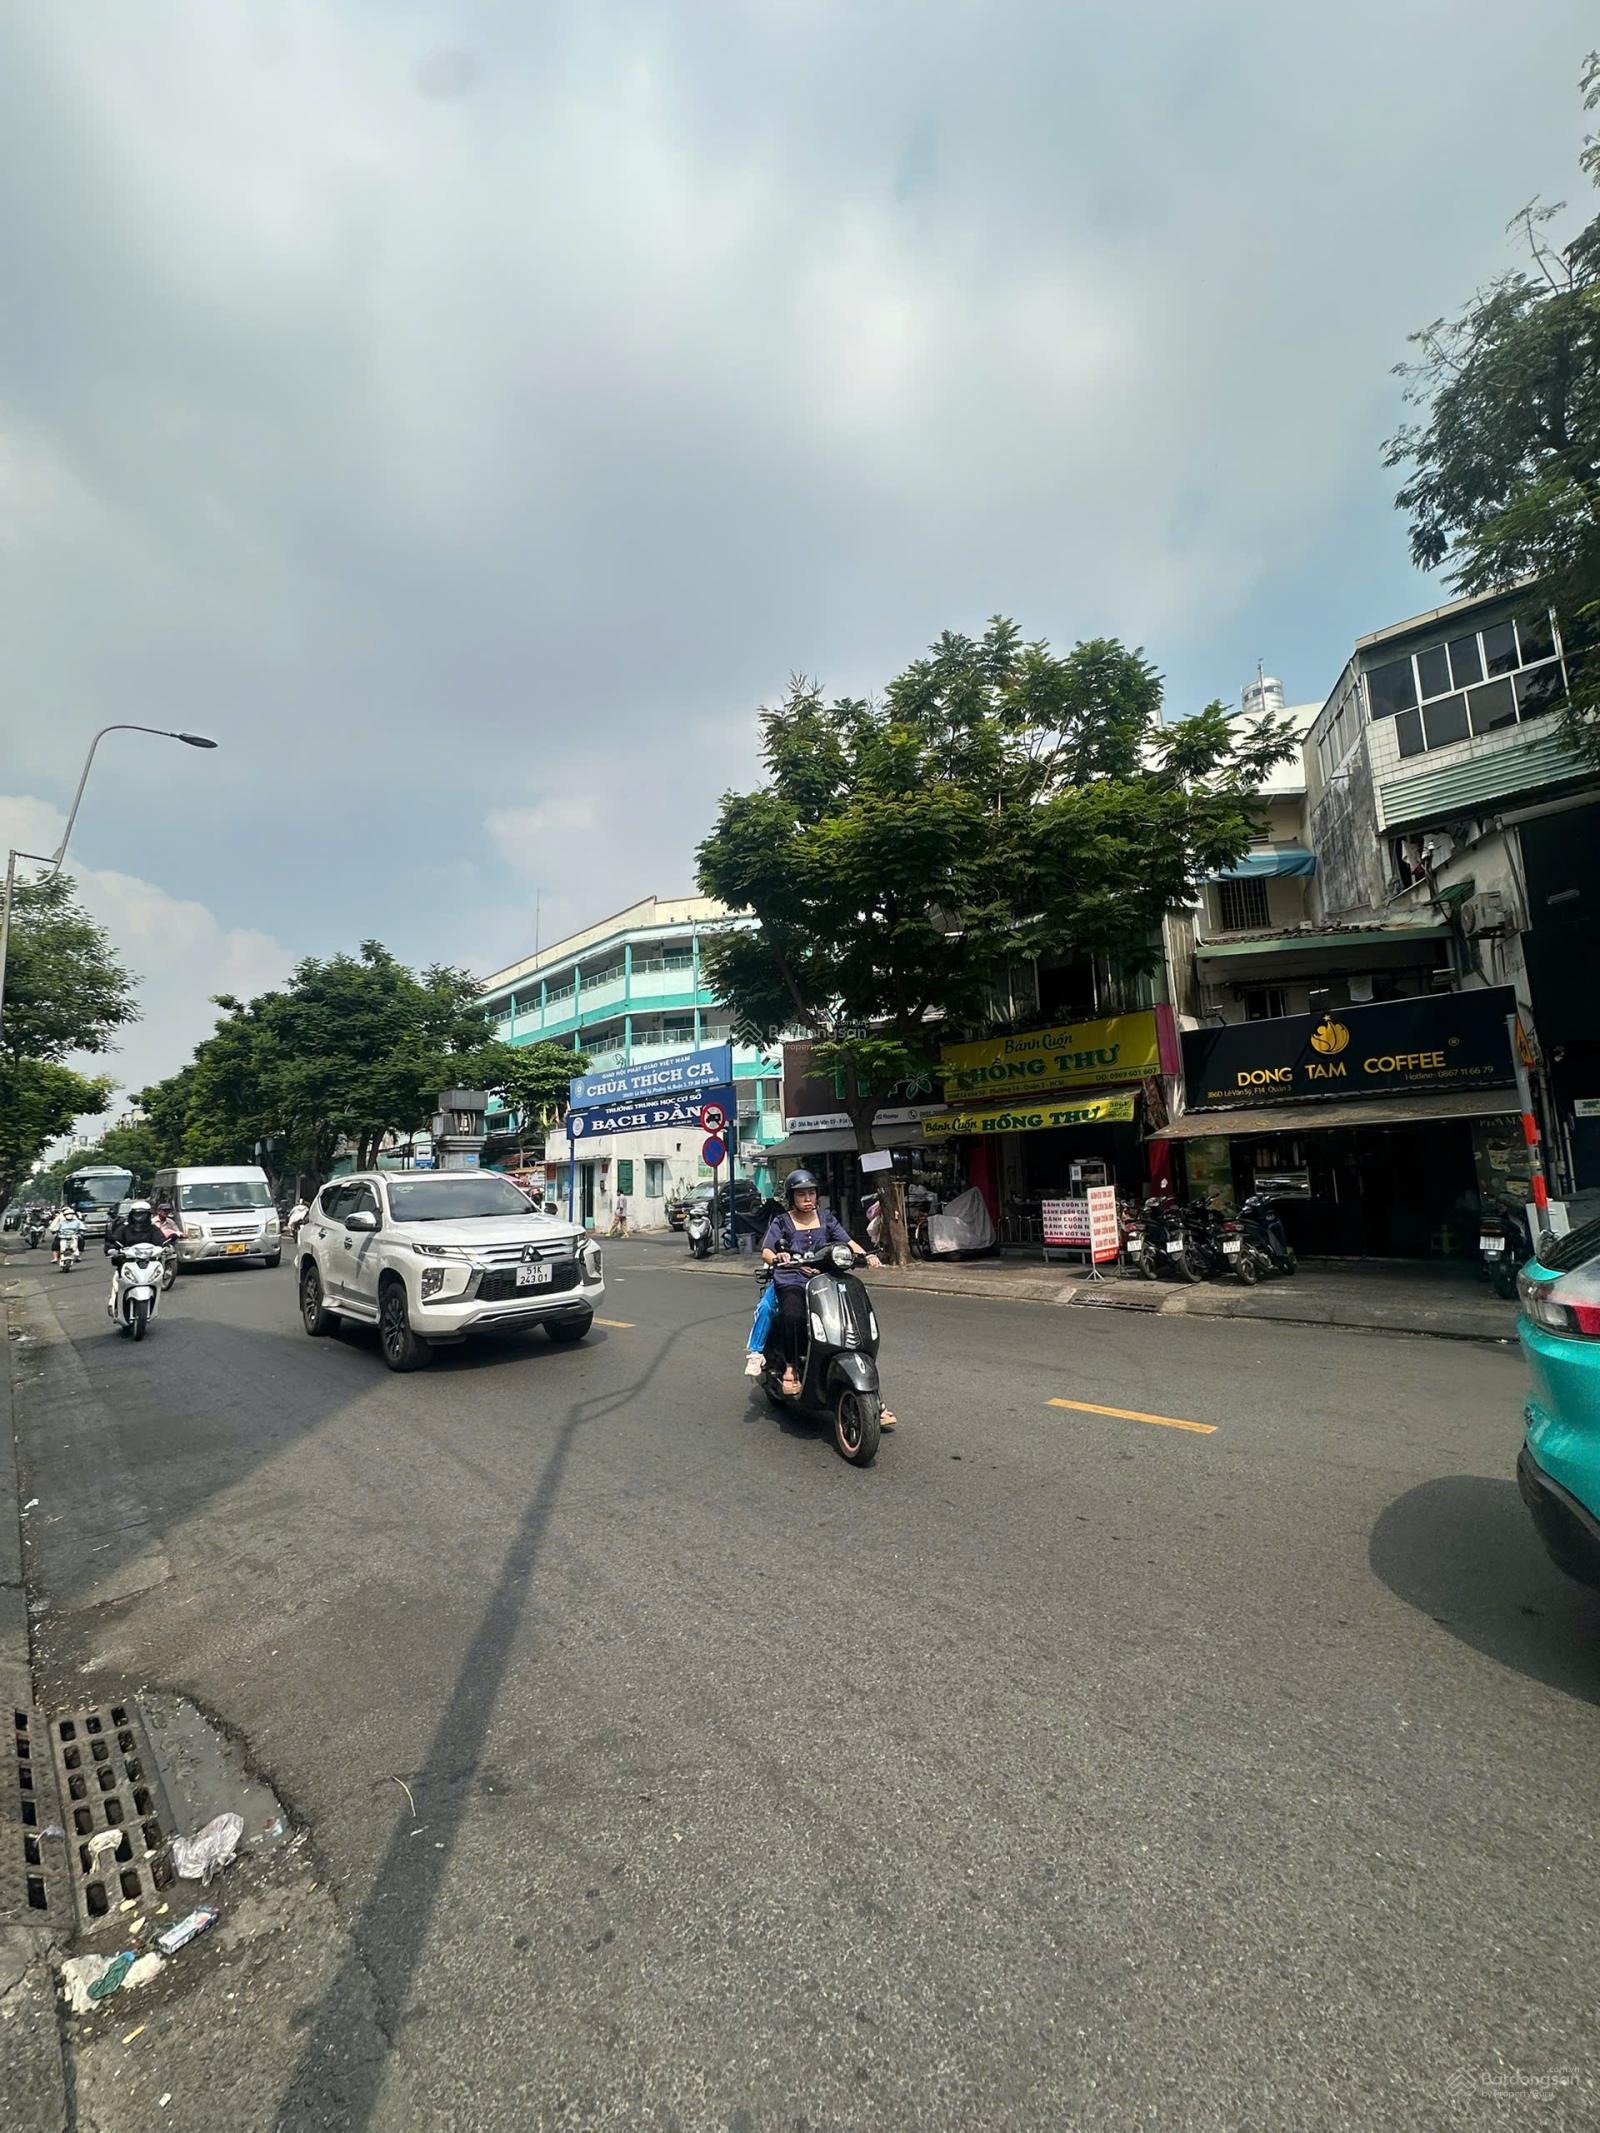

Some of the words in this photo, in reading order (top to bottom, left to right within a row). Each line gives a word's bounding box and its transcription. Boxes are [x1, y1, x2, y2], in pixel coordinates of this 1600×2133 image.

[1004, 1038, 1040, 1054] Bánh
[1042, 1031, 1073, 1050] Cuốn
[675, 1055, 691, 1064] NAM
[1054, 1043, 1120, 1073] THƯ
[1236, 1066, 1294, 1087] DONG
[1304, 1060, 1348, 1081] TAM
[1363, 1050, 1447, 1074] COFFEE
[586, 1079, 627, 1098] CHÙA
[631, 1068, 683, 1089] THÍCH
[687, 1062, 714, 1078] CA
[605, 1104, 633, 1114] TRƯỜNG
[634, 1100, 659, 1110] TRUNG
[660, 1098, 676, 1106] HỌC
[677, 1095, 688, 1103] CƠ
[689, 1091, 702, 1101] SỞ
[592, 1113, 647, 1132] BẠCH
[653, 1103, 704, 1122] ĐẰN
[925, 1120, 951, 1132] Bánh
[952, 1116, 977, 1133] Cuốn
[1049, 1106, 1101, 1125] THƯ
[526, 1265, 542, 1275] 51K
